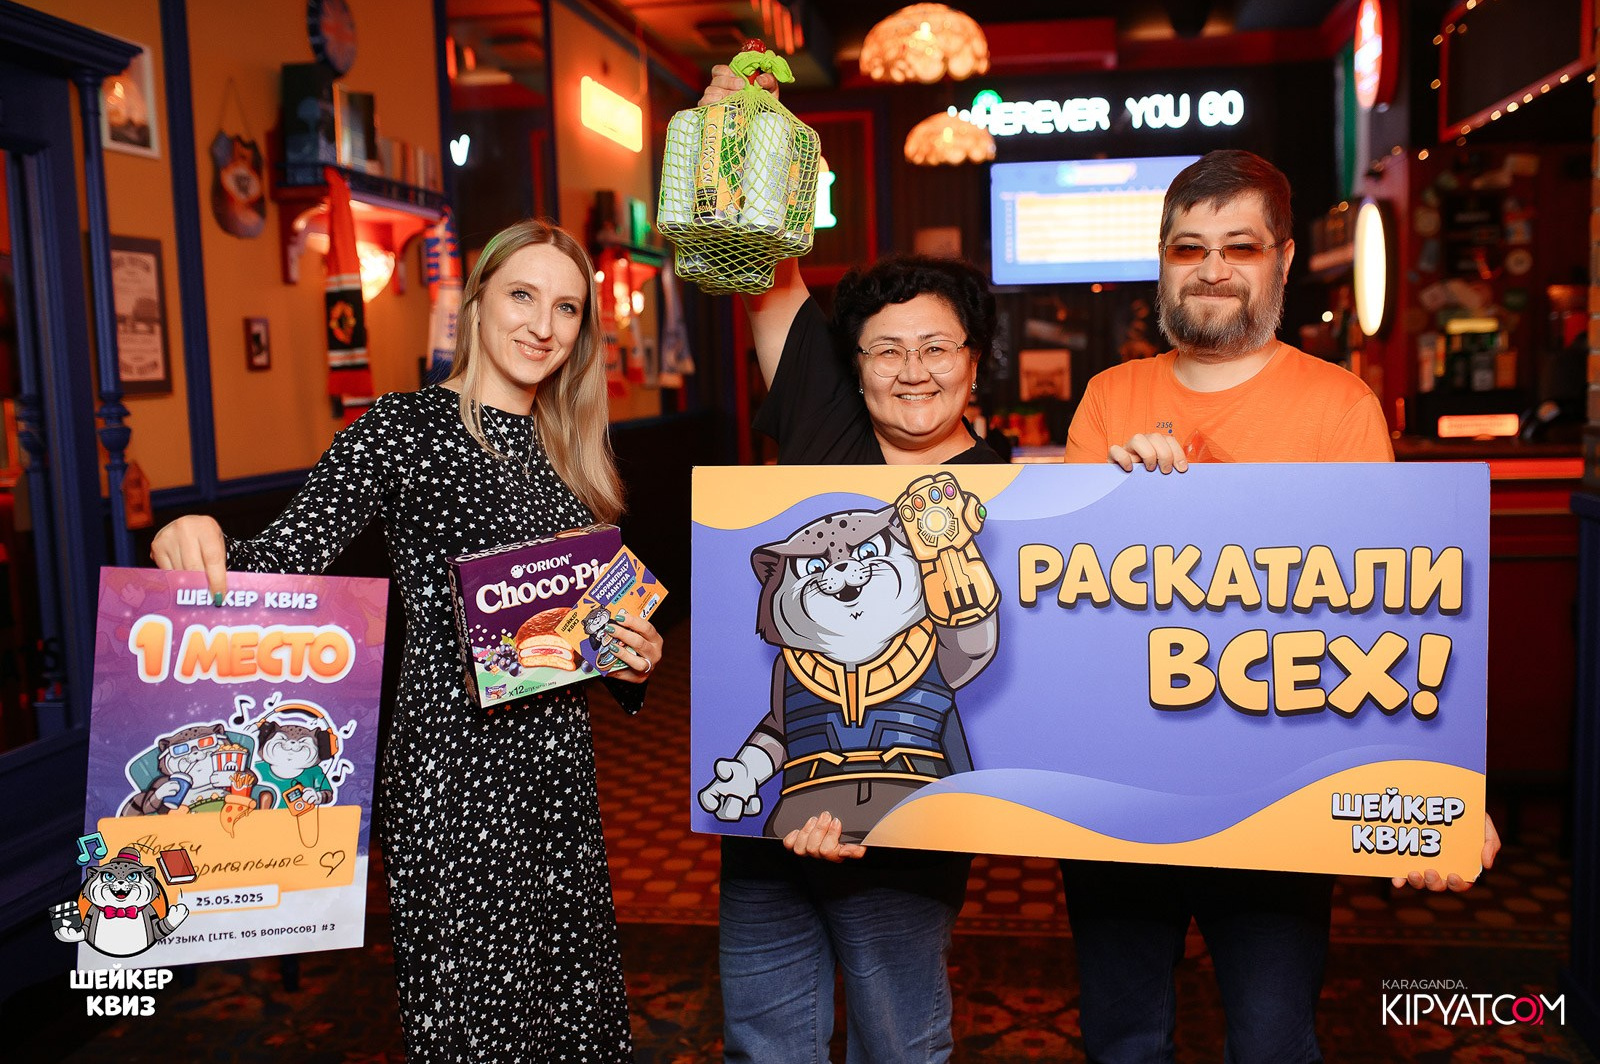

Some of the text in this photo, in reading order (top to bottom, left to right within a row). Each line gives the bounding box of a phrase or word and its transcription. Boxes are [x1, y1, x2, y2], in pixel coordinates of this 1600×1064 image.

[946, 90, 1245, 137] HEREVER YOU GO
[1156, 421, 1173, 429] 2356
[526, 554, 570, 574] ORION
[595, 561, 629, 600] КОРМИЛЬЦУ
[1018, 542, 1464, 615] РАСКАТАЛИ
[264, 591, 318, 610] КВИЗ
[561, 611, 578, 632] ШЕЙКЕР
[567, 618, 579, 632] КВИЗ
[131, 617, 352, 681] 1 МЕСТО
[1148, 626, 1452, 720] ВСЕХ!
[1332, 787, 1465, 826] ШЕЙКЕР
[1352, 824, 1441, 857] КВИЗ
[196, 892, 264, 907] 25.05.2025
[241, 930, 257, 939] 105
[260, 924, 317, 938] ВОПРОСОВ]
